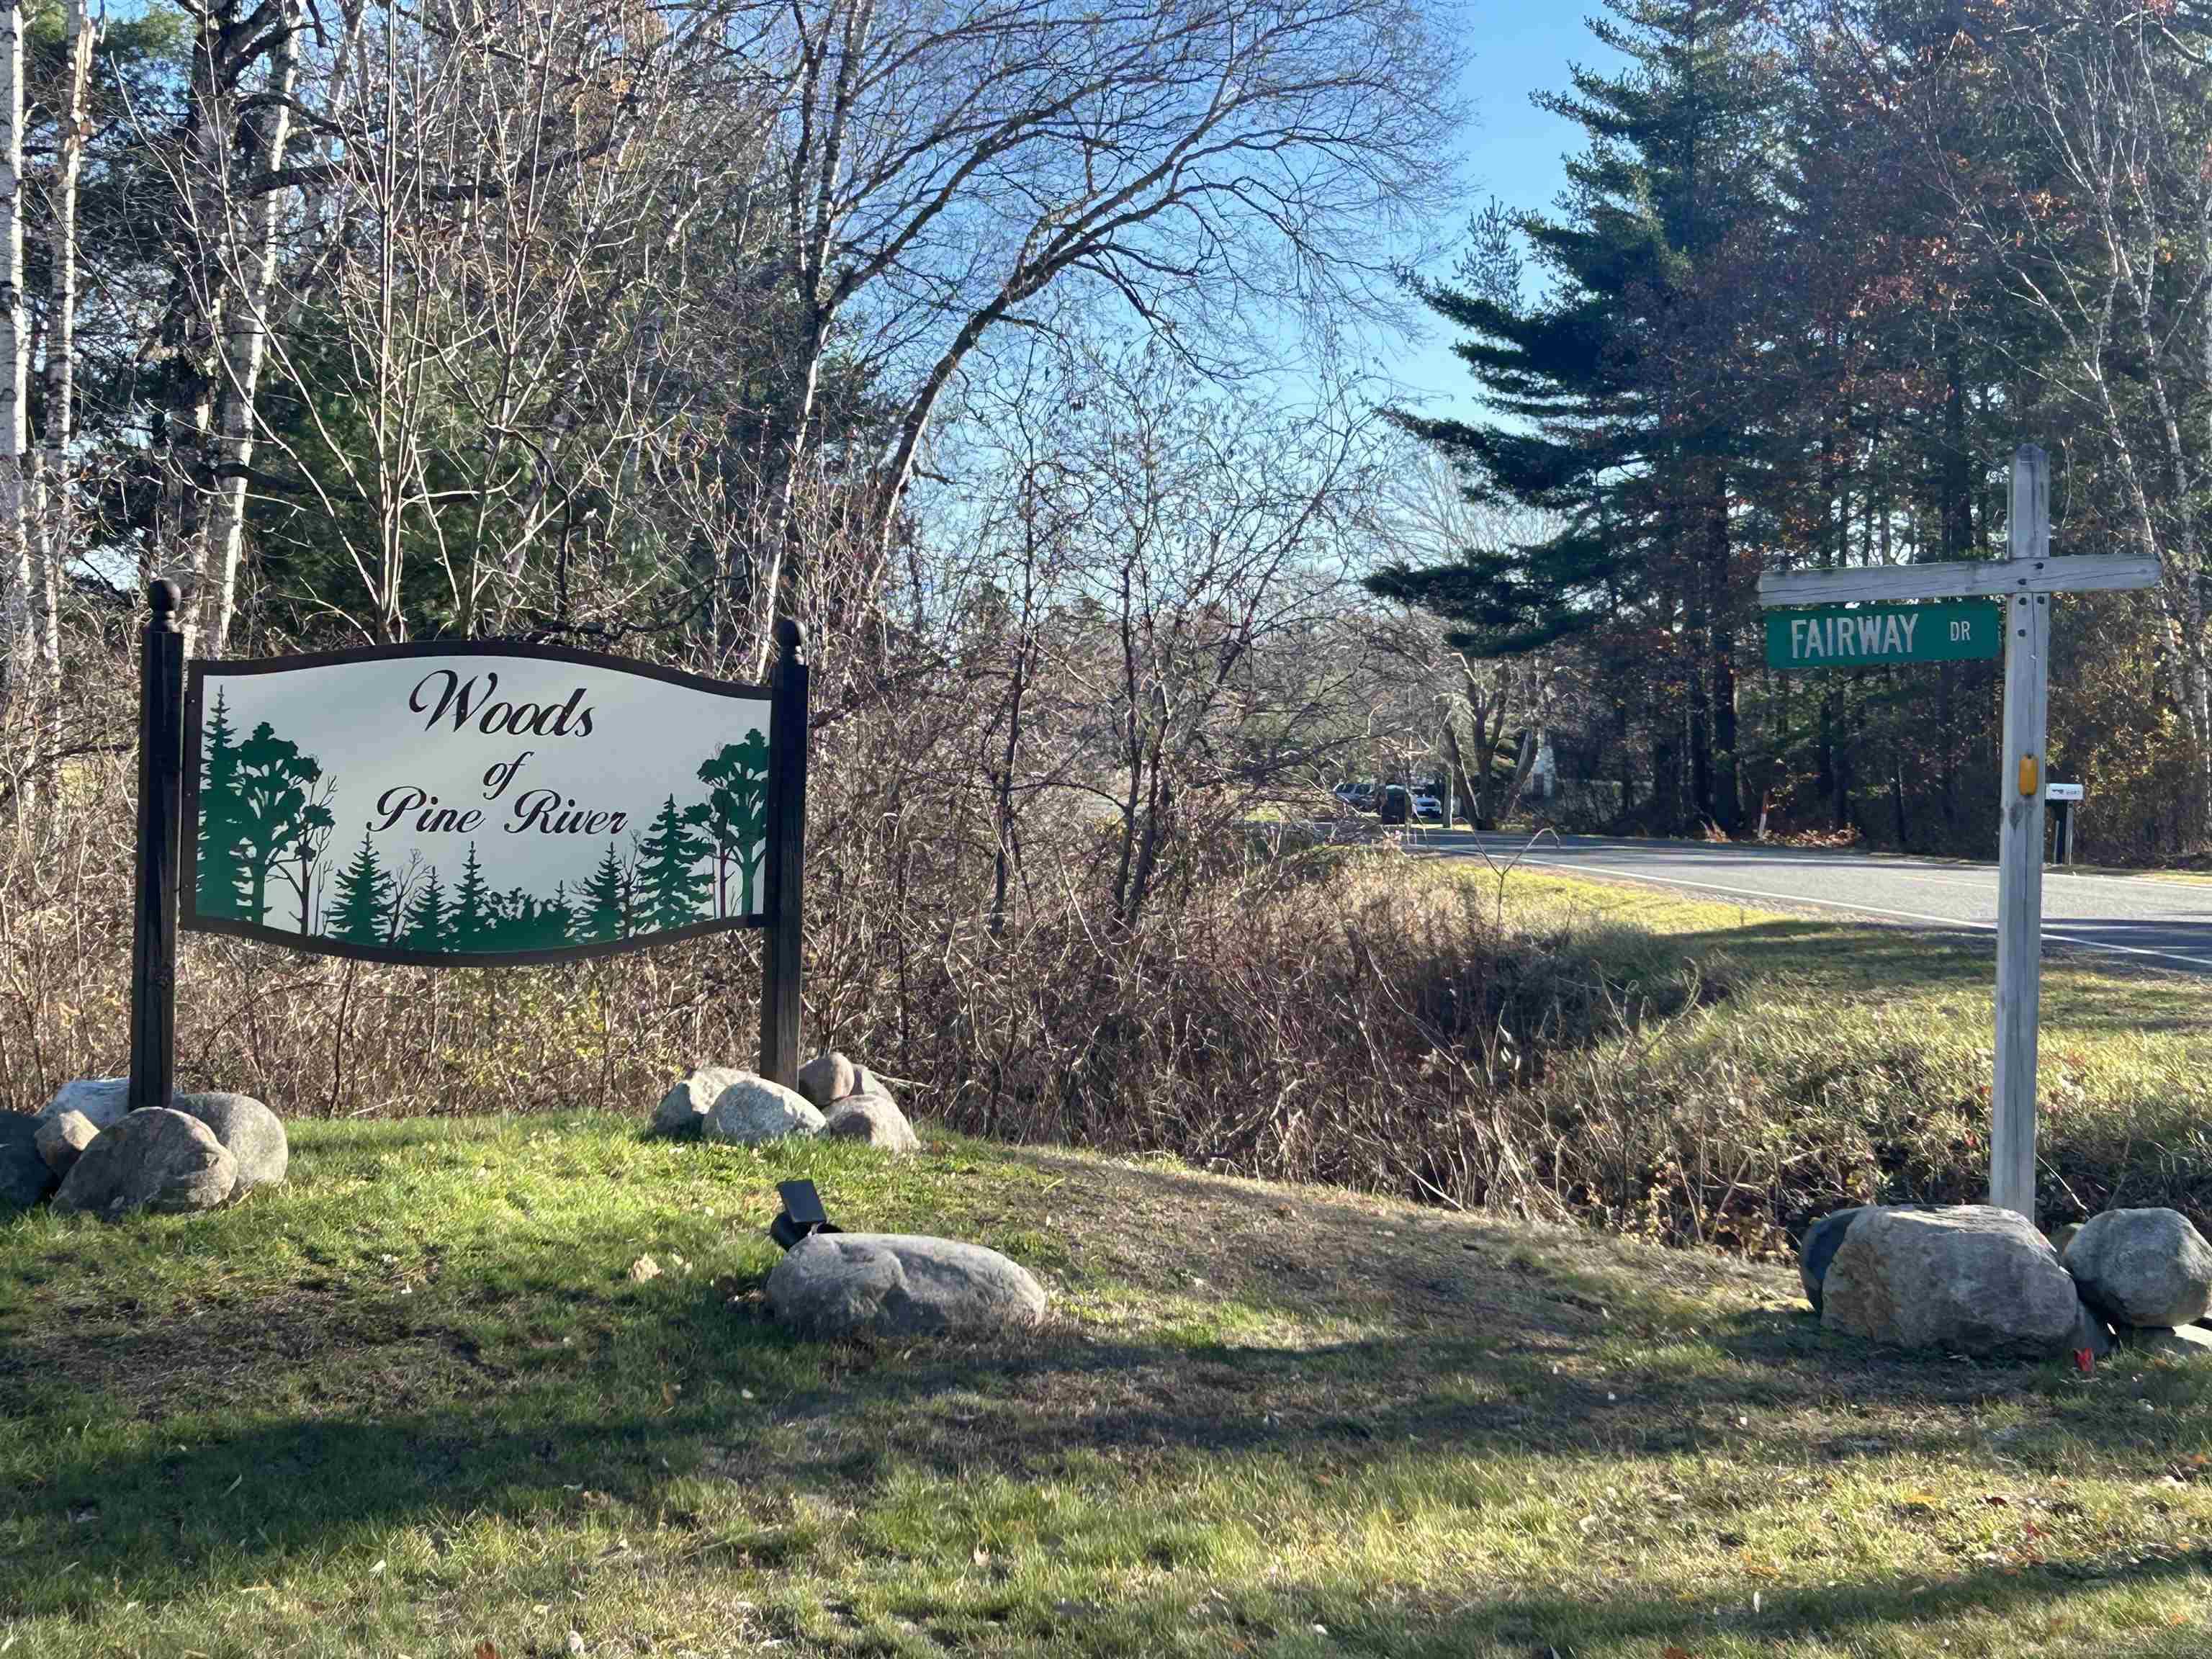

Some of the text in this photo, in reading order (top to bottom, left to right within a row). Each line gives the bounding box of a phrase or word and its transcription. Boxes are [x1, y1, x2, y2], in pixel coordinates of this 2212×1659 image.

[1790, 613, 1972, 659] FAIRWAY DR
[408, 669, 597, 737] Woods
[482, 750, 535, 800] of
[366, 786, 629, 835] Pine River
